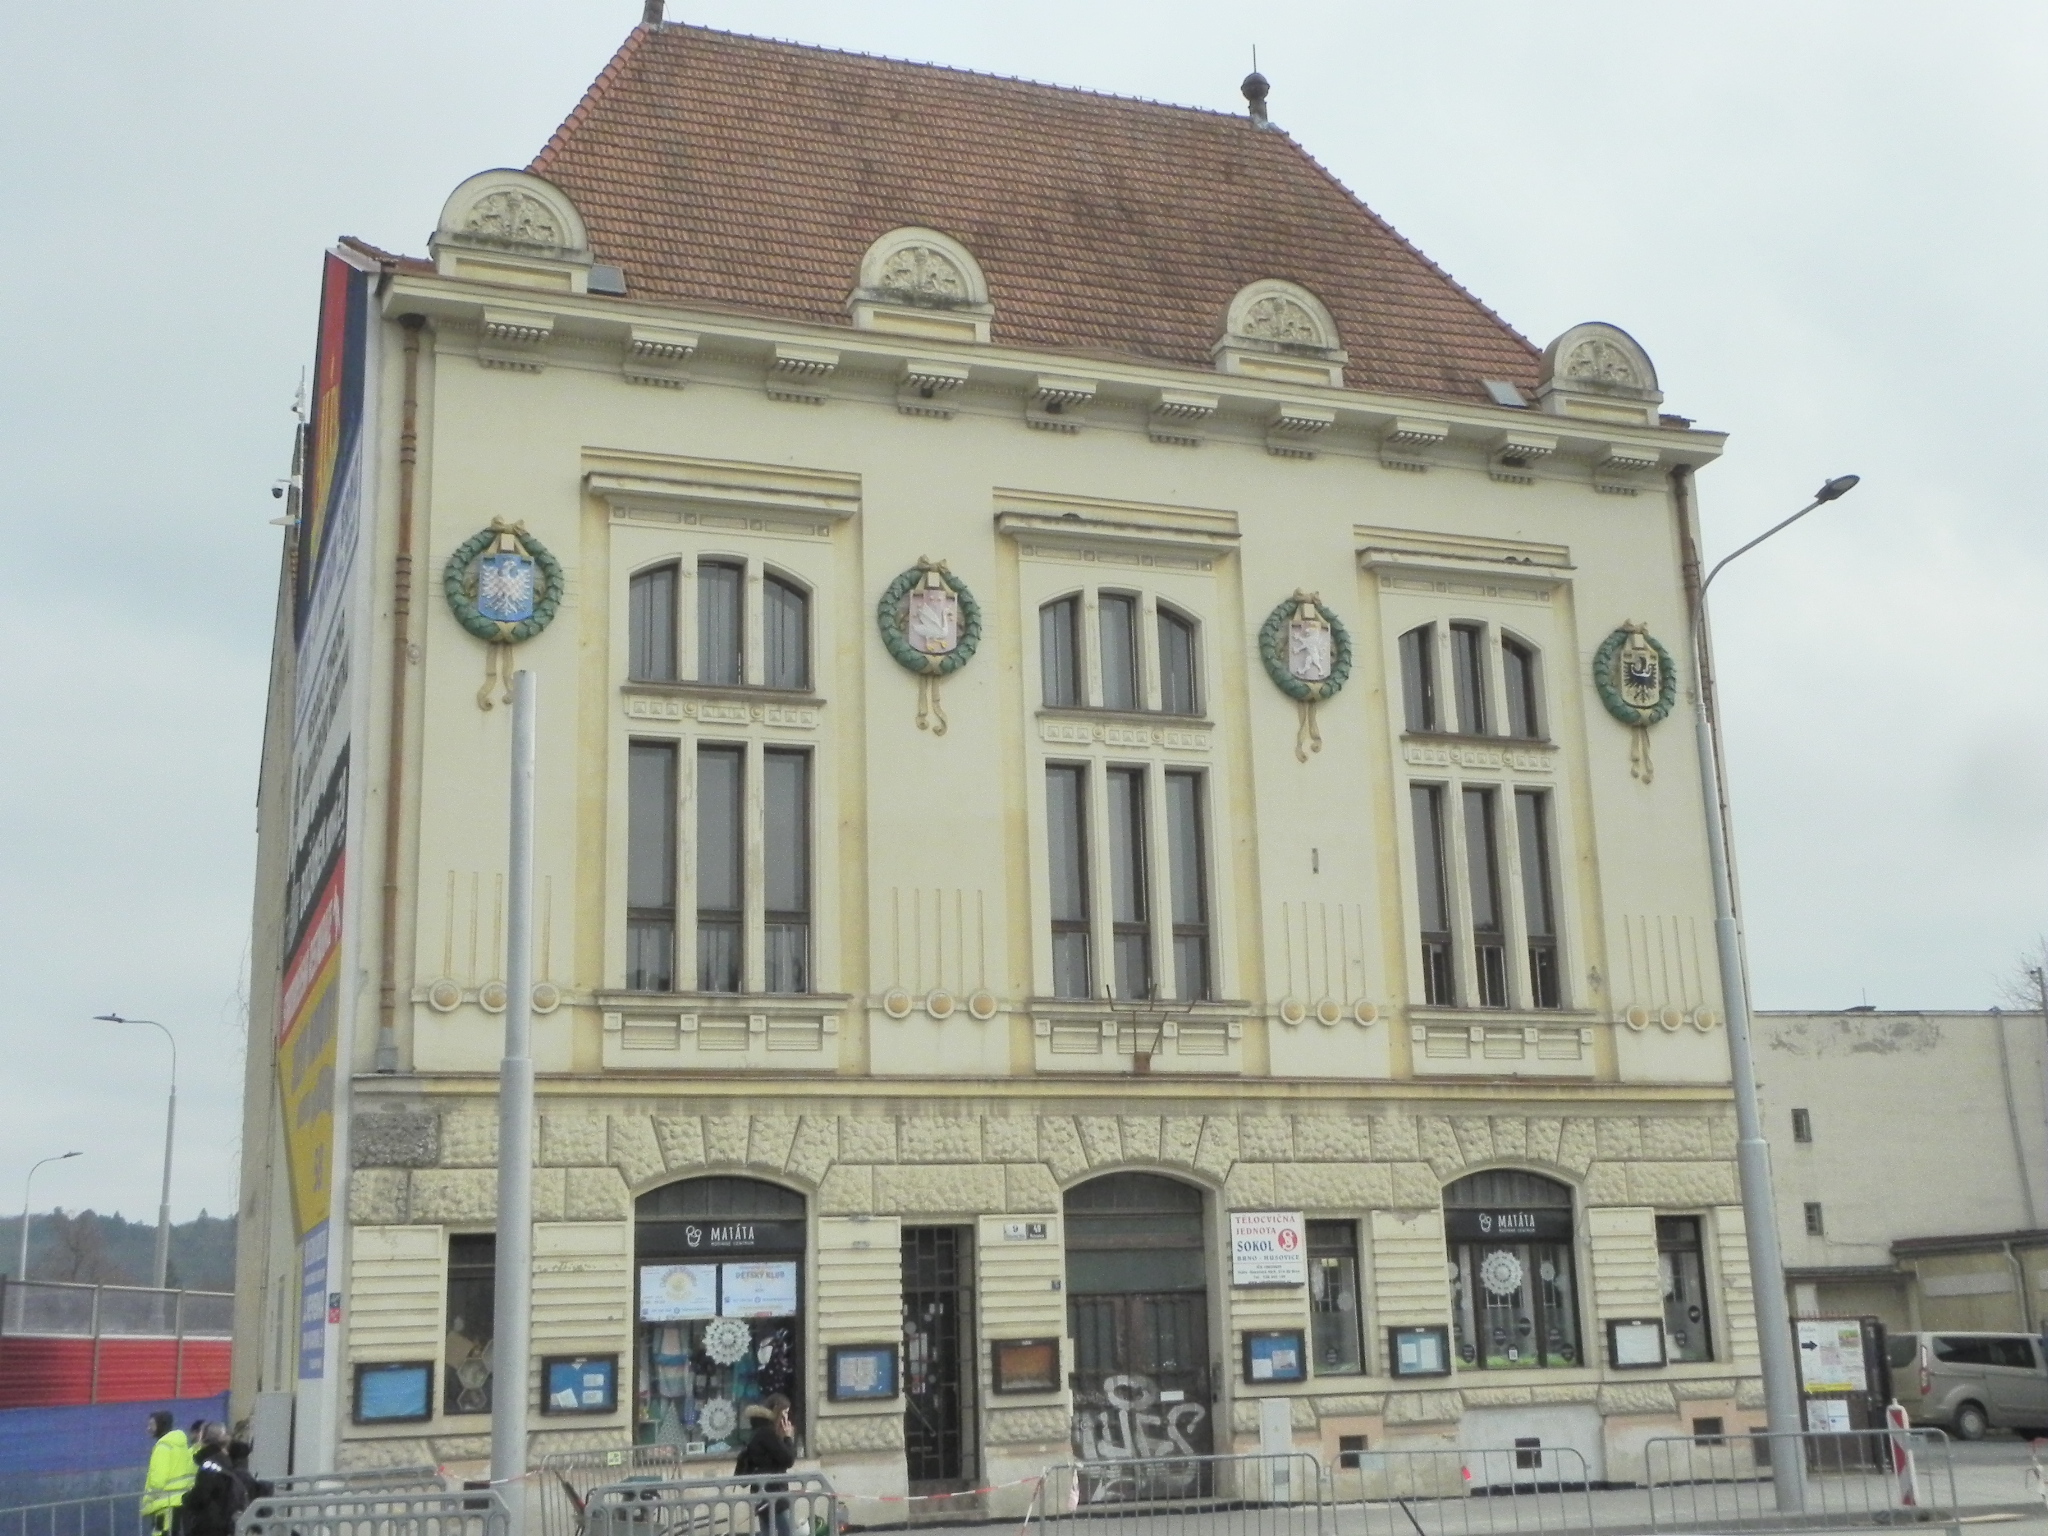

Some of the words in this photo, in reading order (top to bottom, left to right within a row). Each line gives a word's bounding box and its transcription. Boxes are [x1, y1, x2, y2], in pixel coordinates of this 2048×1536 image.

[1236, 1213, 1295, 1223] TĚLOCVIČNÁ
[1498, 1211, 1535, 1228] MATÁTA
[711, 1223, 755, 1241] MATÁTA
[1237, 1240, 1275, 1252] SOKOL
